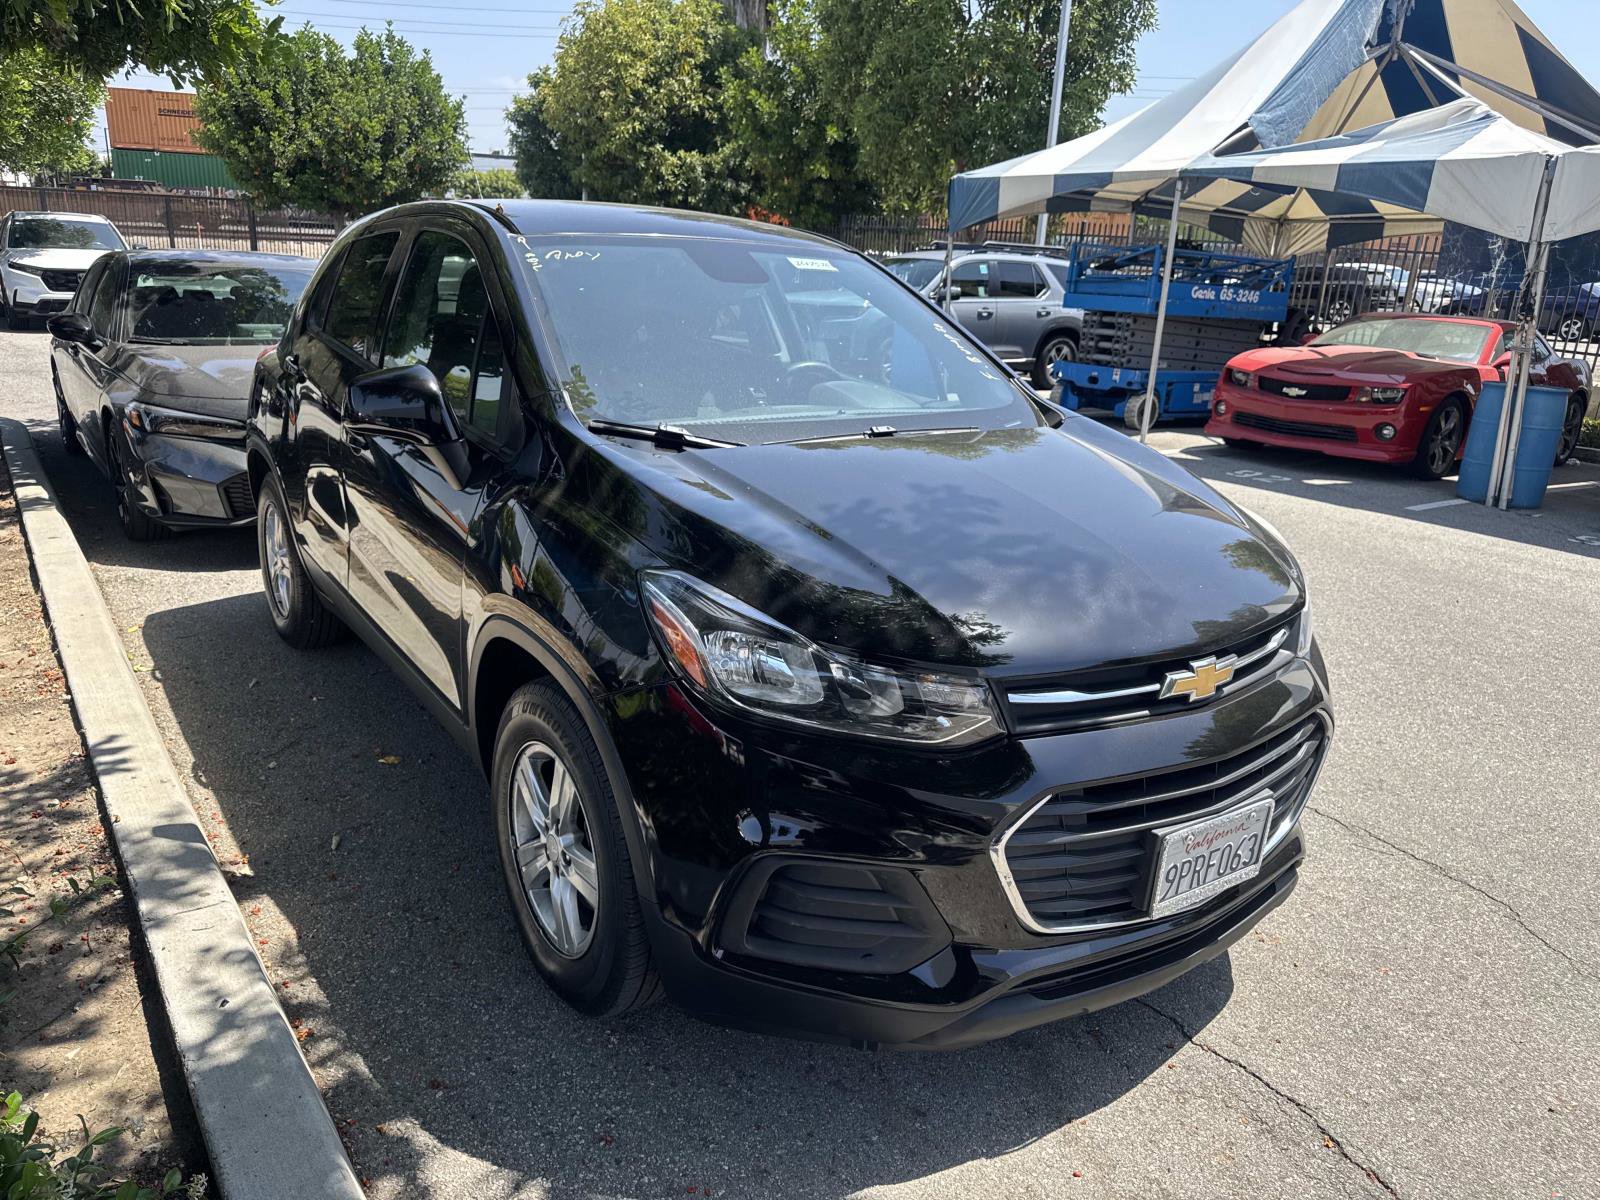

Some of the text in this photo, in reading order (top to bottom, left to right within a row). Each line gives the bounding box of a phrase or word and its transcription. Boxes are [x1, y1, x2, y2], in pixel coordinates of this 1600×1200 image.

[1191, 286, 1260, 303] Genie GS-3246
[1185, 822, 1250, 855] California
[1161, 831, 1259, 901] 9PRF063
